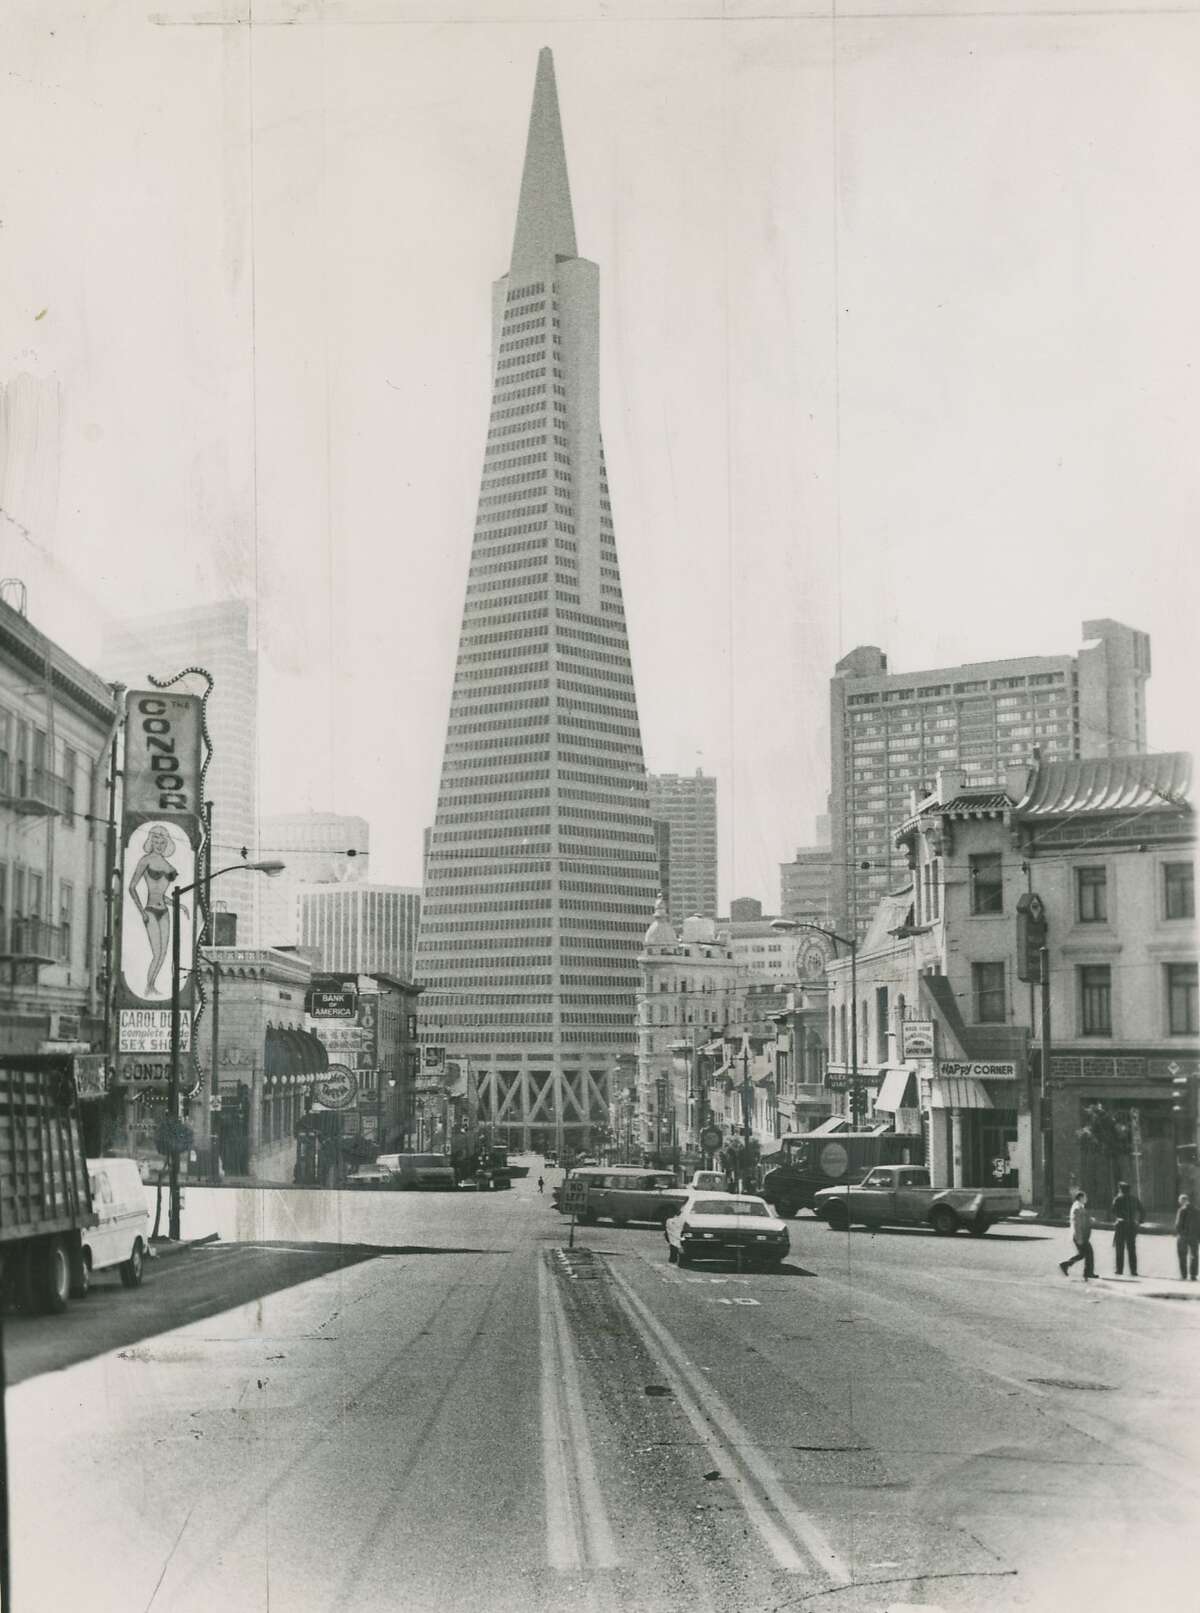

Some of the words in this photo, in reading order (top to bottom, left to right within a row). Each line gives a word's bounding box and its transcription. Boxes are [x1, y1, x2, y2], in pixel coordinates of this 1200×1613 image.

[138, 699, 188, 810] CONDOR
[322, 994, 345, 1002] BANK
[314, 1007, 352, 1016] AMERICA
[121, 1011, 157, 1028] CAROL
[160, 1011, 190, 1028] DOA
[361, 1002, 375, 1066] TOSCA
[121, 1039, 146, 1051] SEX
[974, 1065, 1014, 1075] CORNER
[570, 1182, 584, 1192] NO
